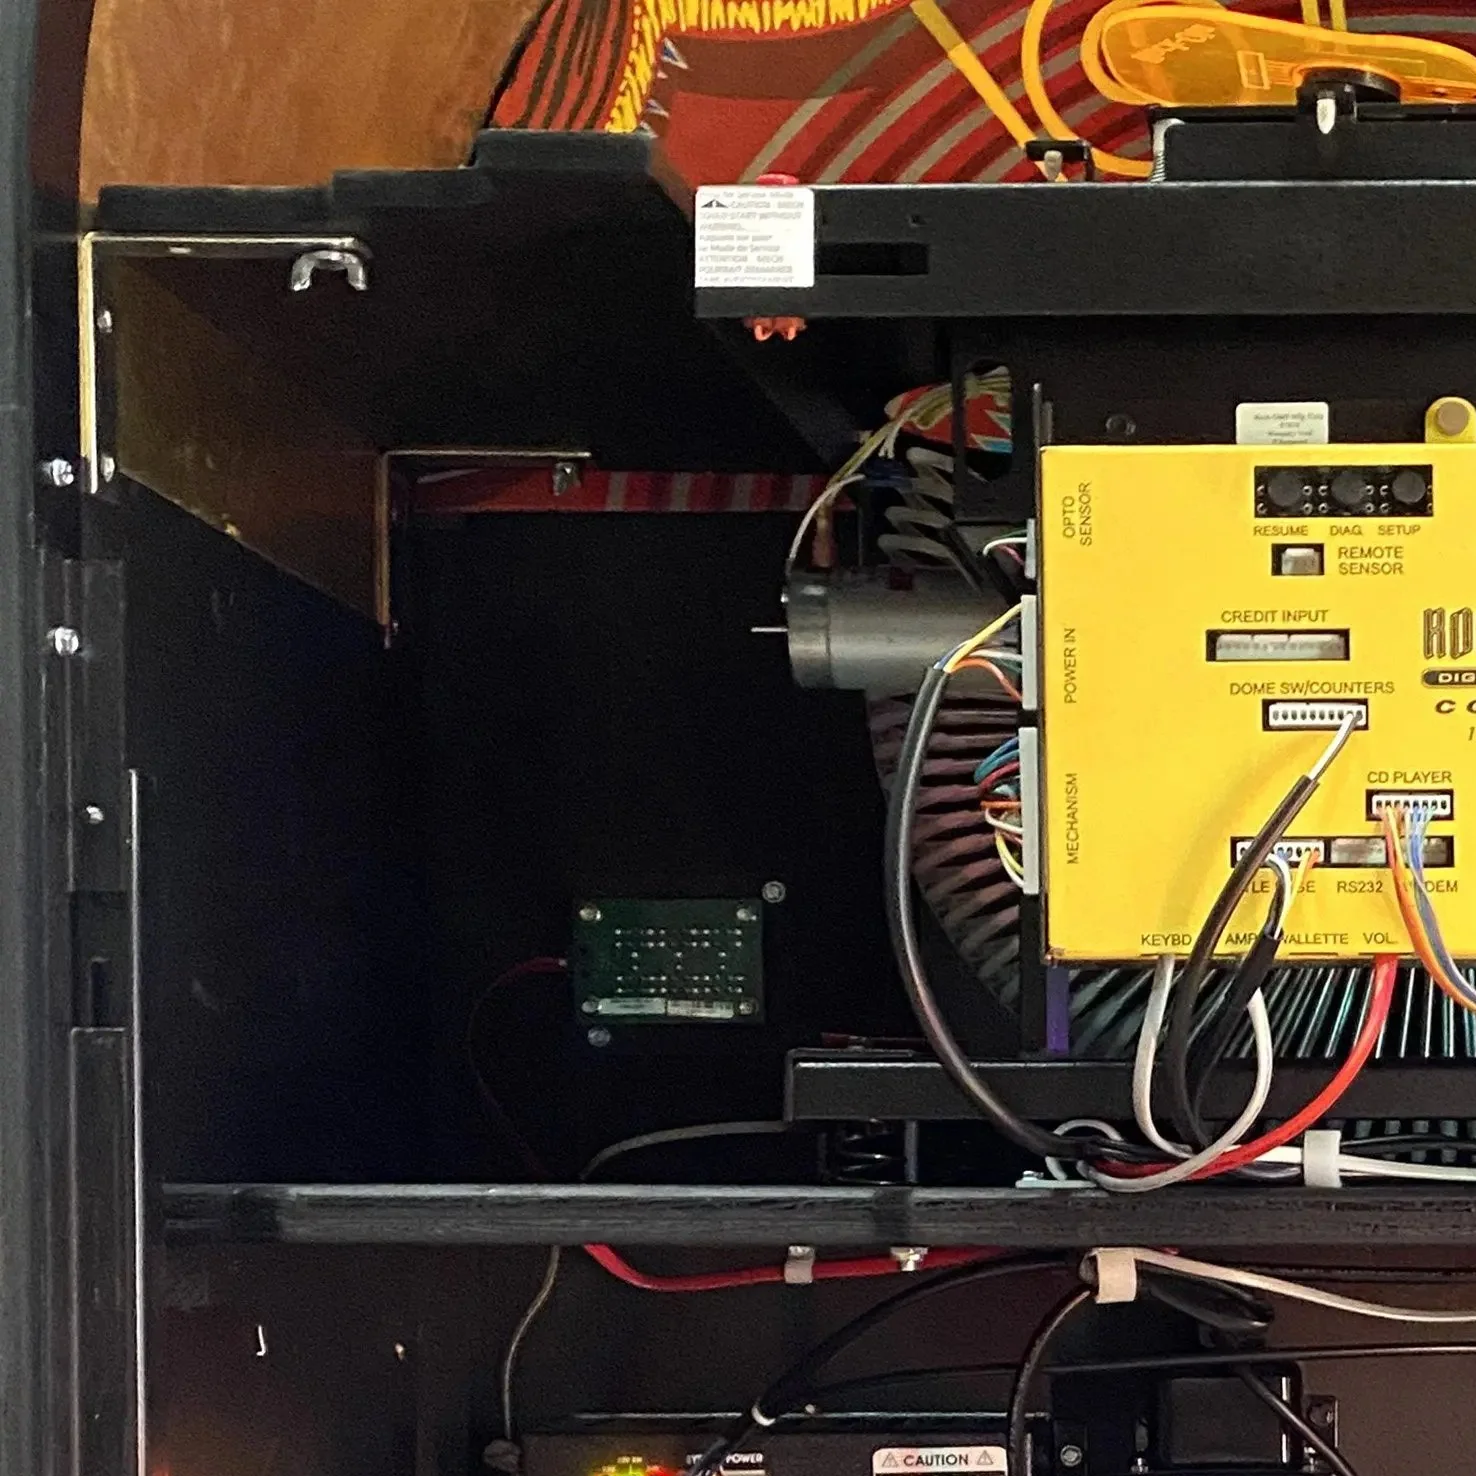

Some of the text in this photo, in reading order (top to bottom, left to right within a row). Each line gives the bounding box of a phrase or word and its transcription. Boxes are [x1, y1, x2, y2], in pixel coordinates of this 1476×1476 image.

[1062, 495, 1076, 539] OPTO
[1079, 481, 1093, 546] SENSOR
[1253, 523, 1309, 537] RESUME
[1377, 523, 1421, 536] SETUP
[1337, 546, 1404, 559] REMOTE
[1337, 562, 1404, 576] SENSOR
[1220, 609, 1329, 624] CREDIT INPUT
[1063, 627, 1077, 703] POWER IN
[1229, 680, 1395, 696] DOME SW/COUNTERS
[1367, 770, 1452, 784] CD PLAYER
[1066, 773, 1079, 865] MECHANISM
[1337, 880, 1383, 894] RS232
[1140, 933, 1192, 946] KEYBD
[725, 1452, 764, 1465] POWER
[903, 1453, 969, 1468] CAUTION
